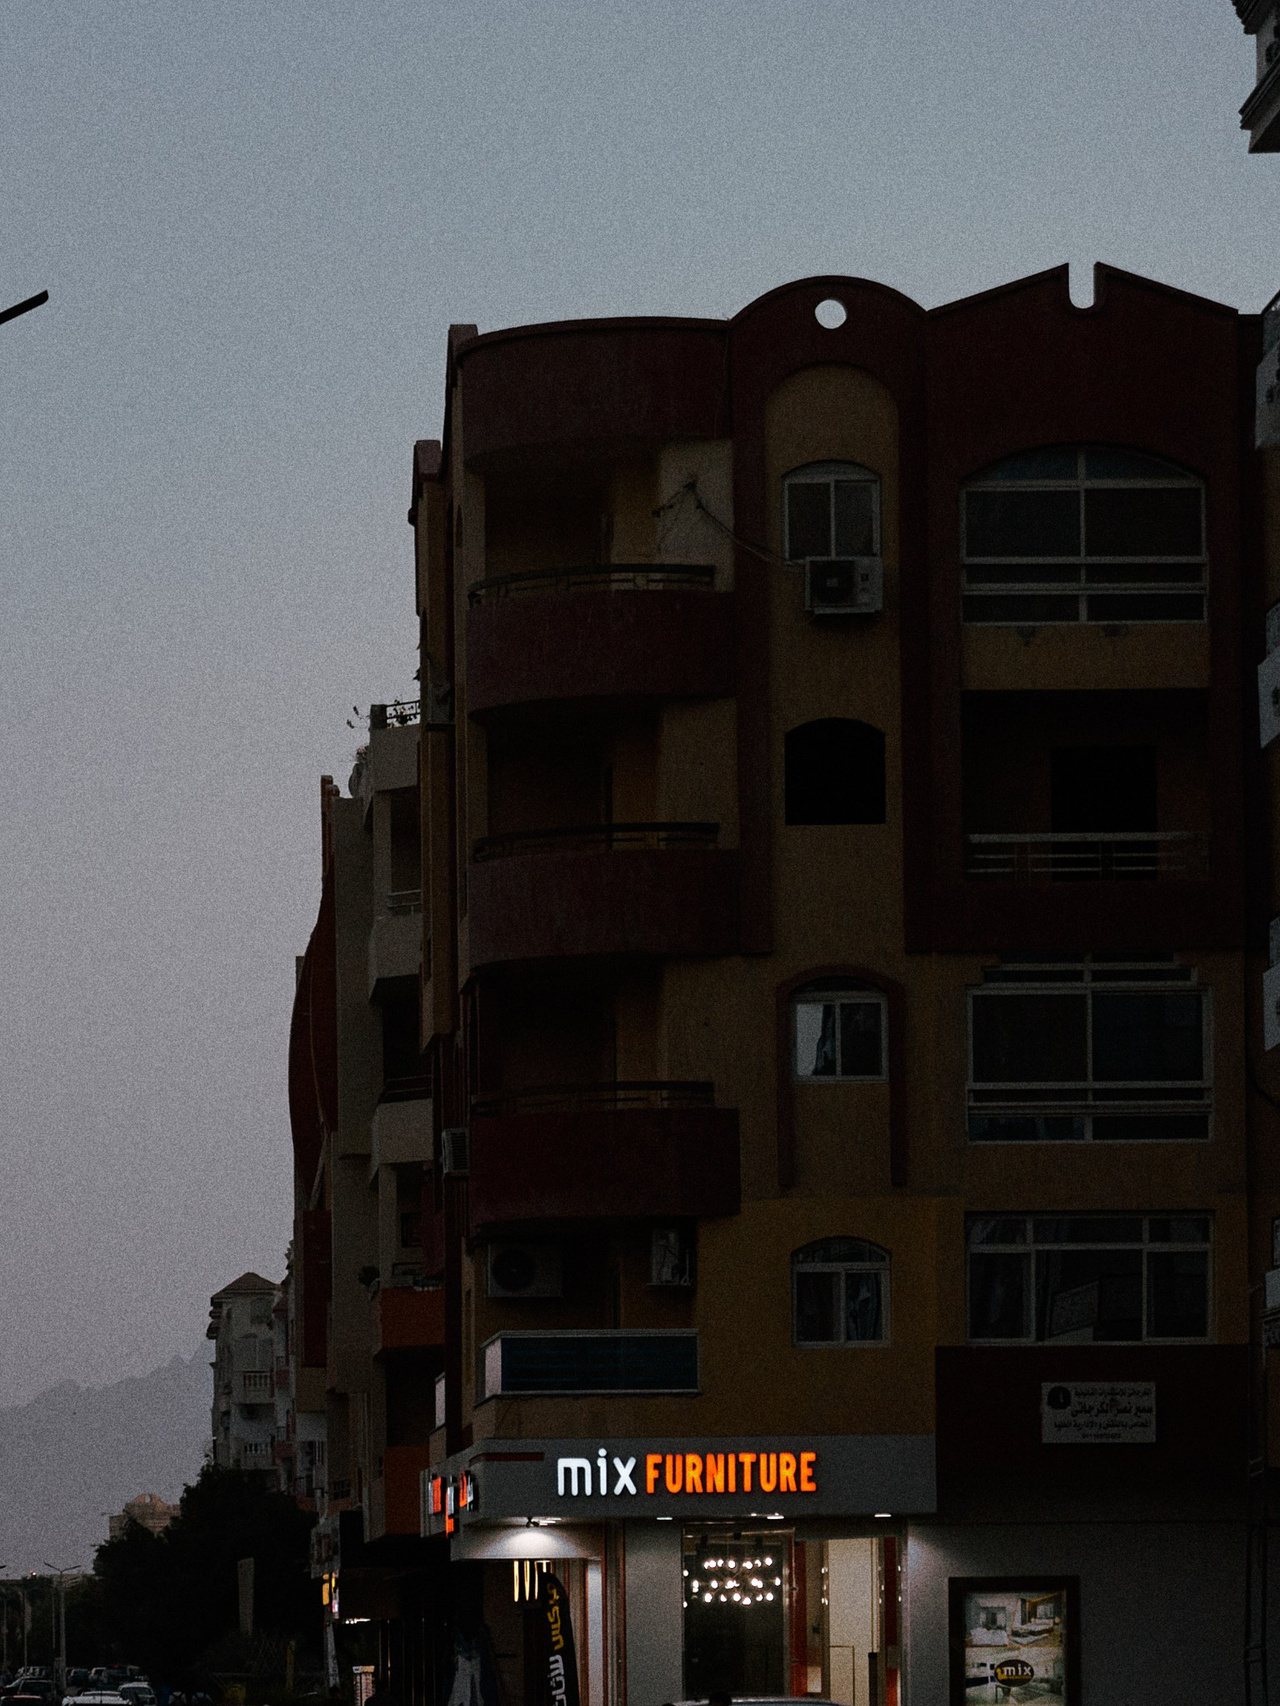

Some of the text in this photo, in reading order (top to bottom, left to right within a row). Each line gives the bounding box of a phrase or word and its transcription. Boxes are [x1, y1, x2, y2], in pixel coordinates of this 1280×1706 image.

[557, 1448, 818, 1496] mix FURNITURE
[1003, 1663, 1032, 1676] mix
